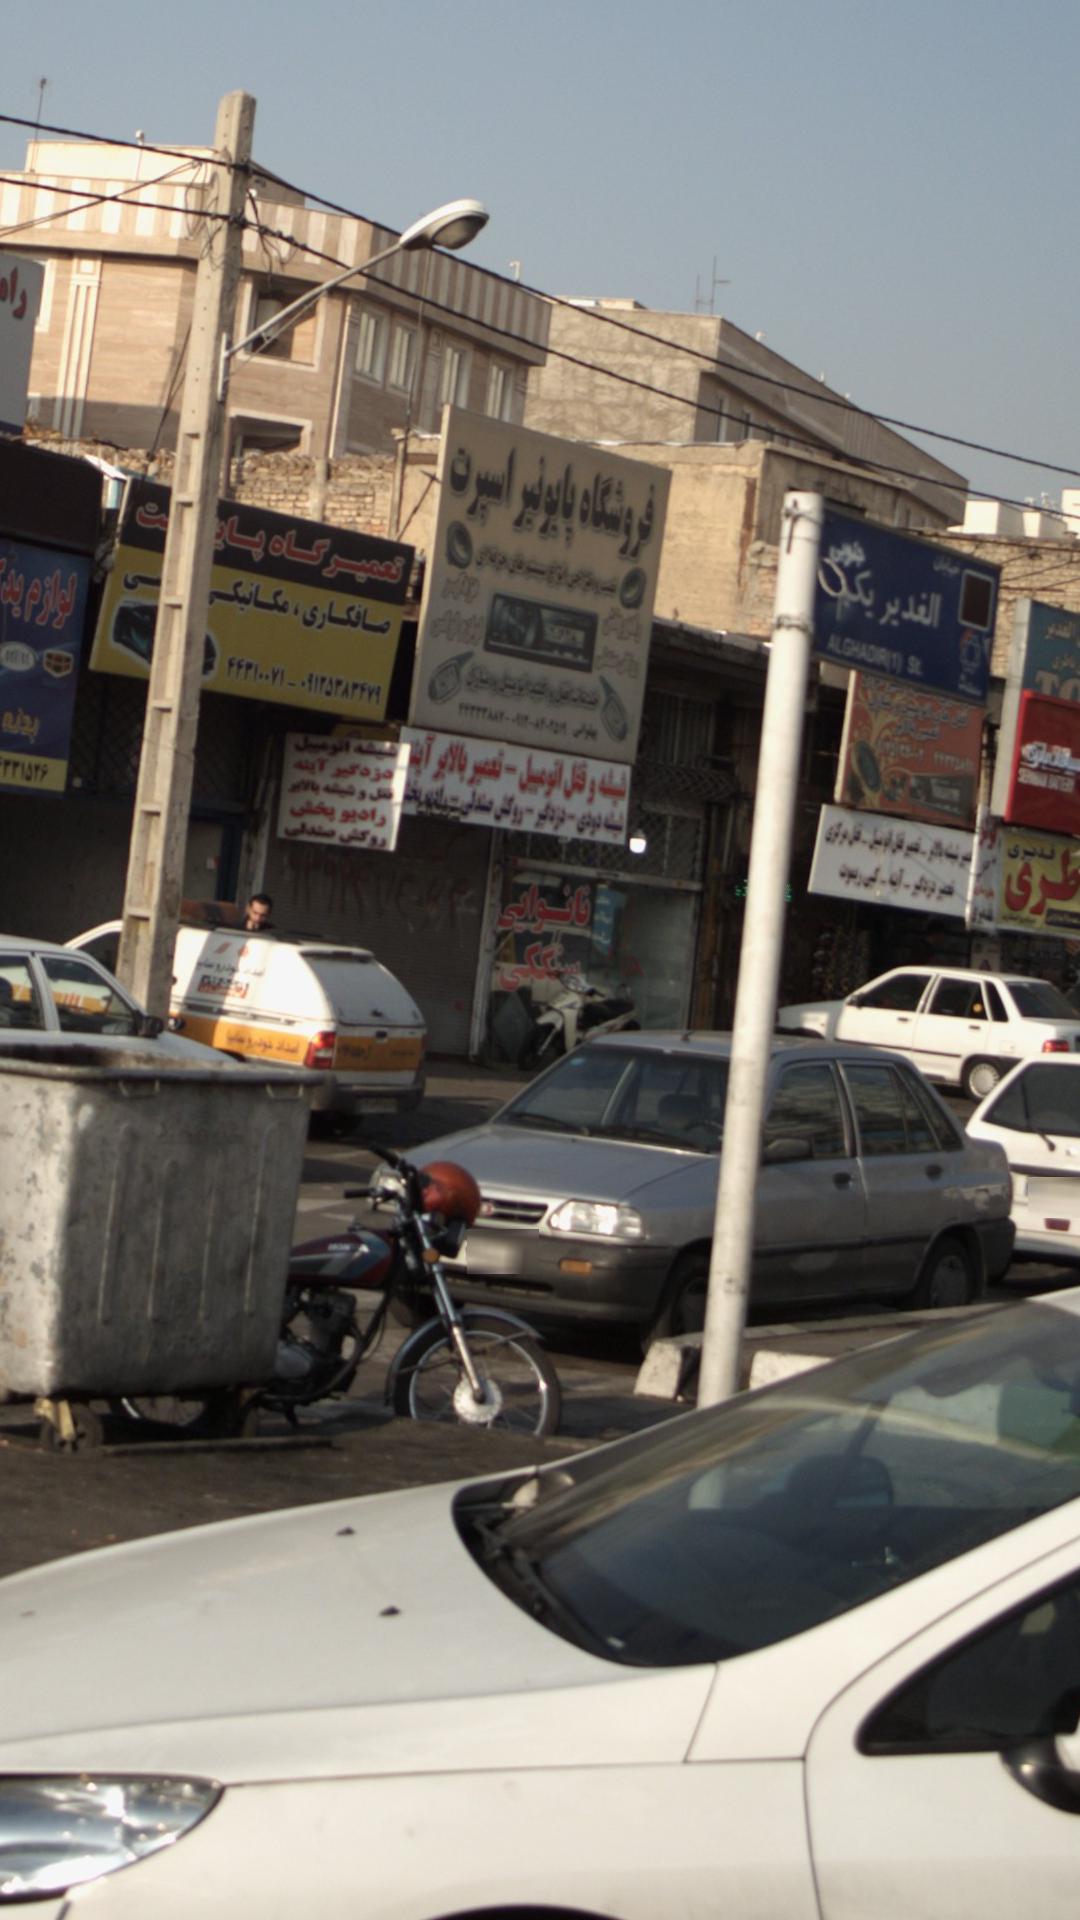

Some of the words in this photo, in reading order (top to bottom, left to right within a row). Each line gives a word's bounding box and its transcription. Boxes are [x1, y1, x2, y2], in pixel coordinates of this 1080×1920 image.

[581, 472, 655, 558] فروشگاه
[26, 569, 78, 630] لوازم
[301, 599, 393, 636] صافکاری
[880, 592, 941, 628] الغدیر
[518, 753, 564, 799] اتومبیل
[290, 800, 336, 823] پخش
[338, 807, 387, 828] رادیو
[339, 828, 387, 848] روکش
[496, 880, 592, 932] نانوایی
